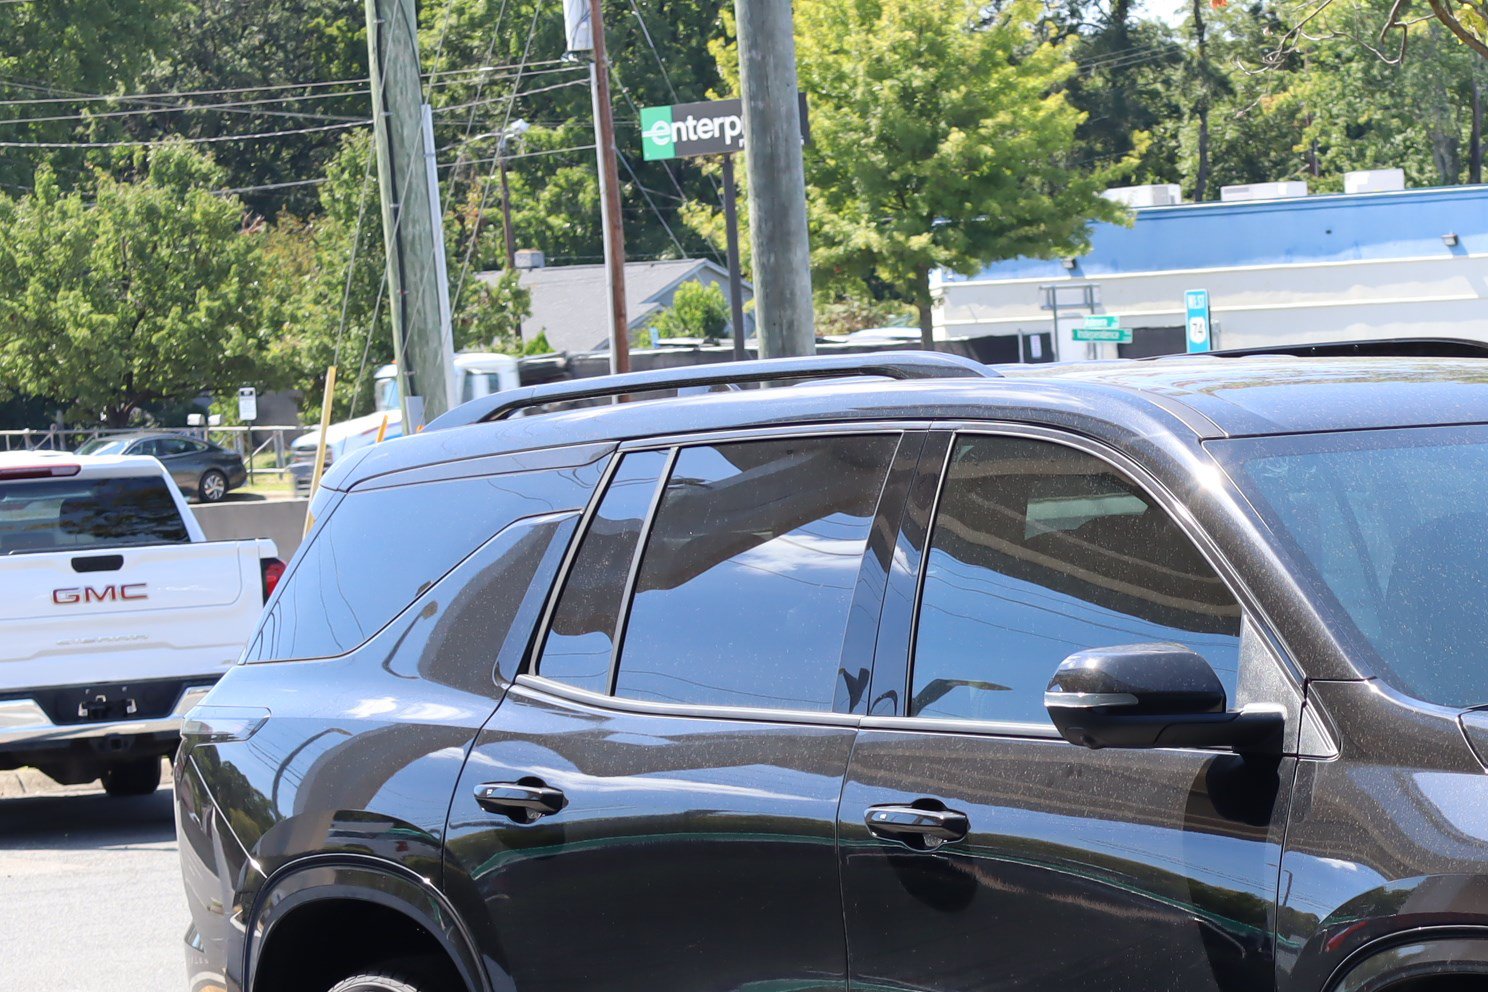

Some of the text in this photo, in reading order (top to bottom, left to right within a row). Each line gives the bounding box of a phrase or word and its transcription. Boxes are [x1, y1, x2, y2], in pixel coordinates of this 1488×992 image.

[642, 115, 745, 146] enterp
[1191, 322, 1205, 338] 74
[53, 583, 149, 604] GMC
